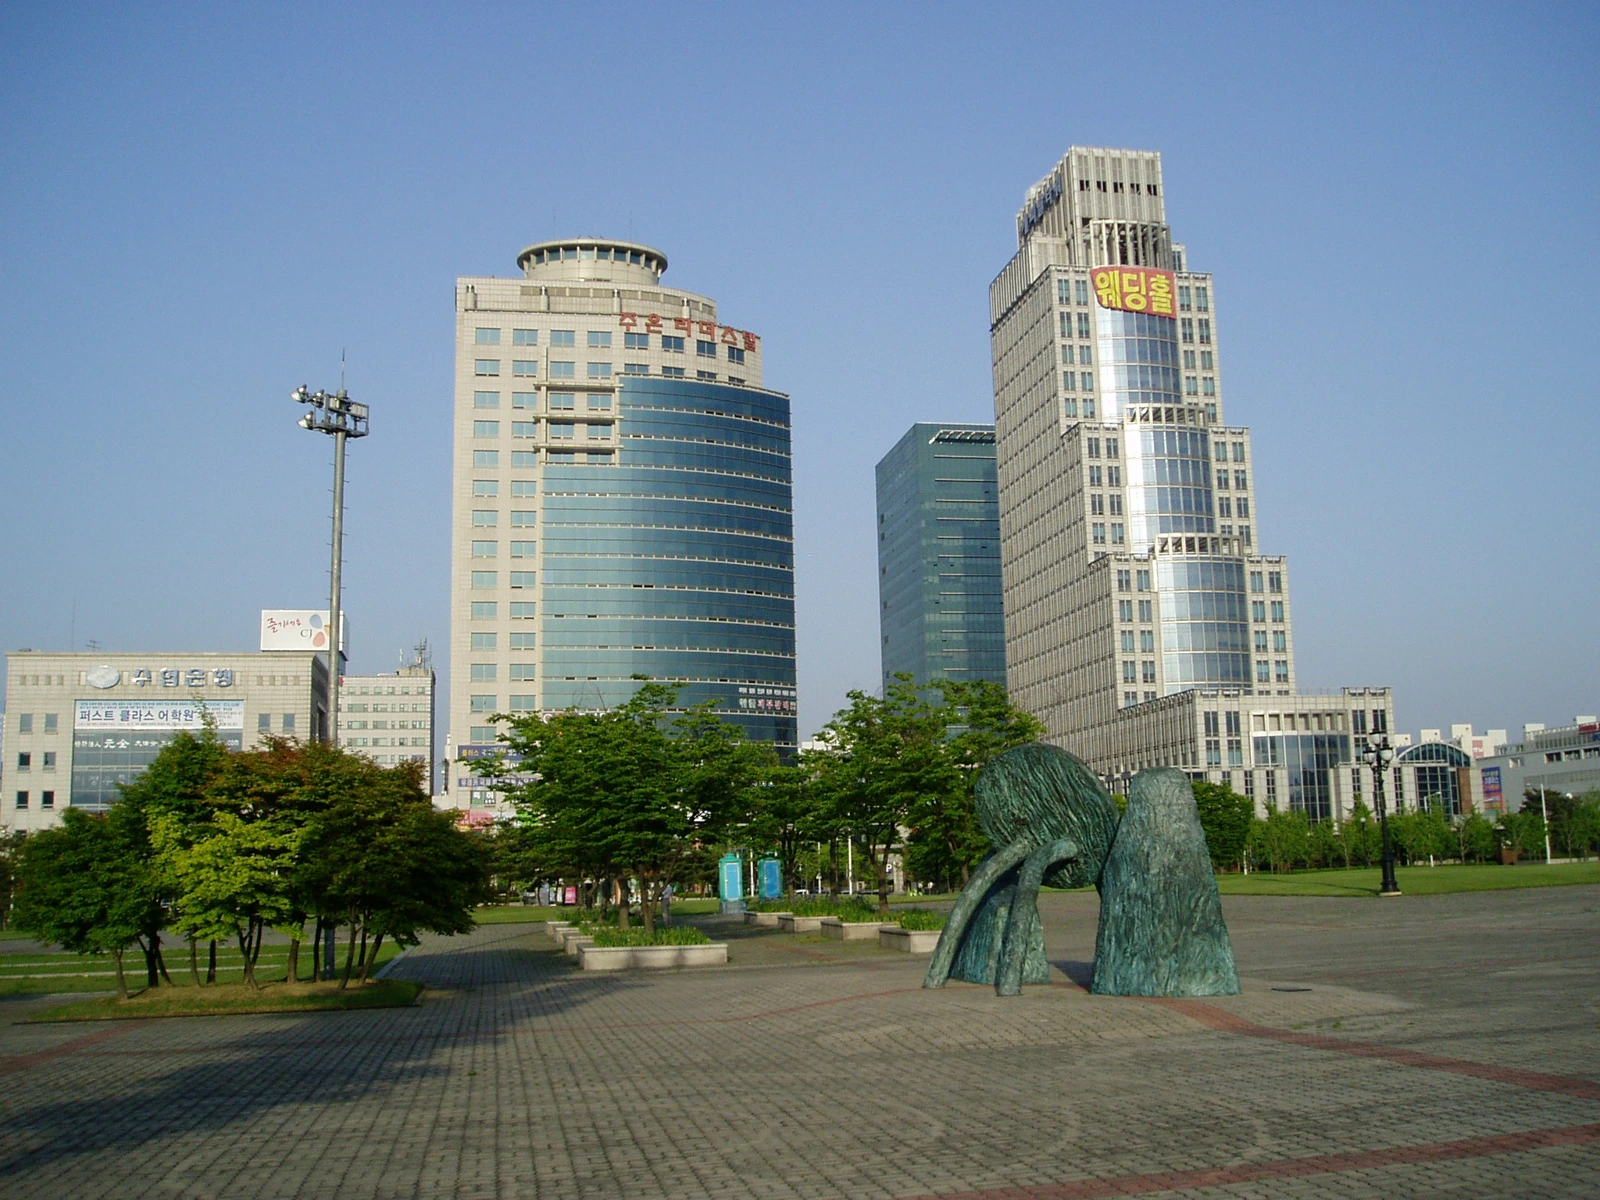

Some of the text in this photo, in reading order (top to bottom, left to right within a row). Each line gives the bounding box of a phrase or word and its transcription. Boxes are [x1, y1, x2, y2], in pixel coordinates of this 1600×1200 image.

[1095, 270, 1173, 314] 웨딩홀
[301, 629, 313, 638] CJ
[132, 668, 233, 687] 수협은행
[79, 709, 194, 722] 퍼스트 클라스 어학원
[886, 863, 893, 873] P
